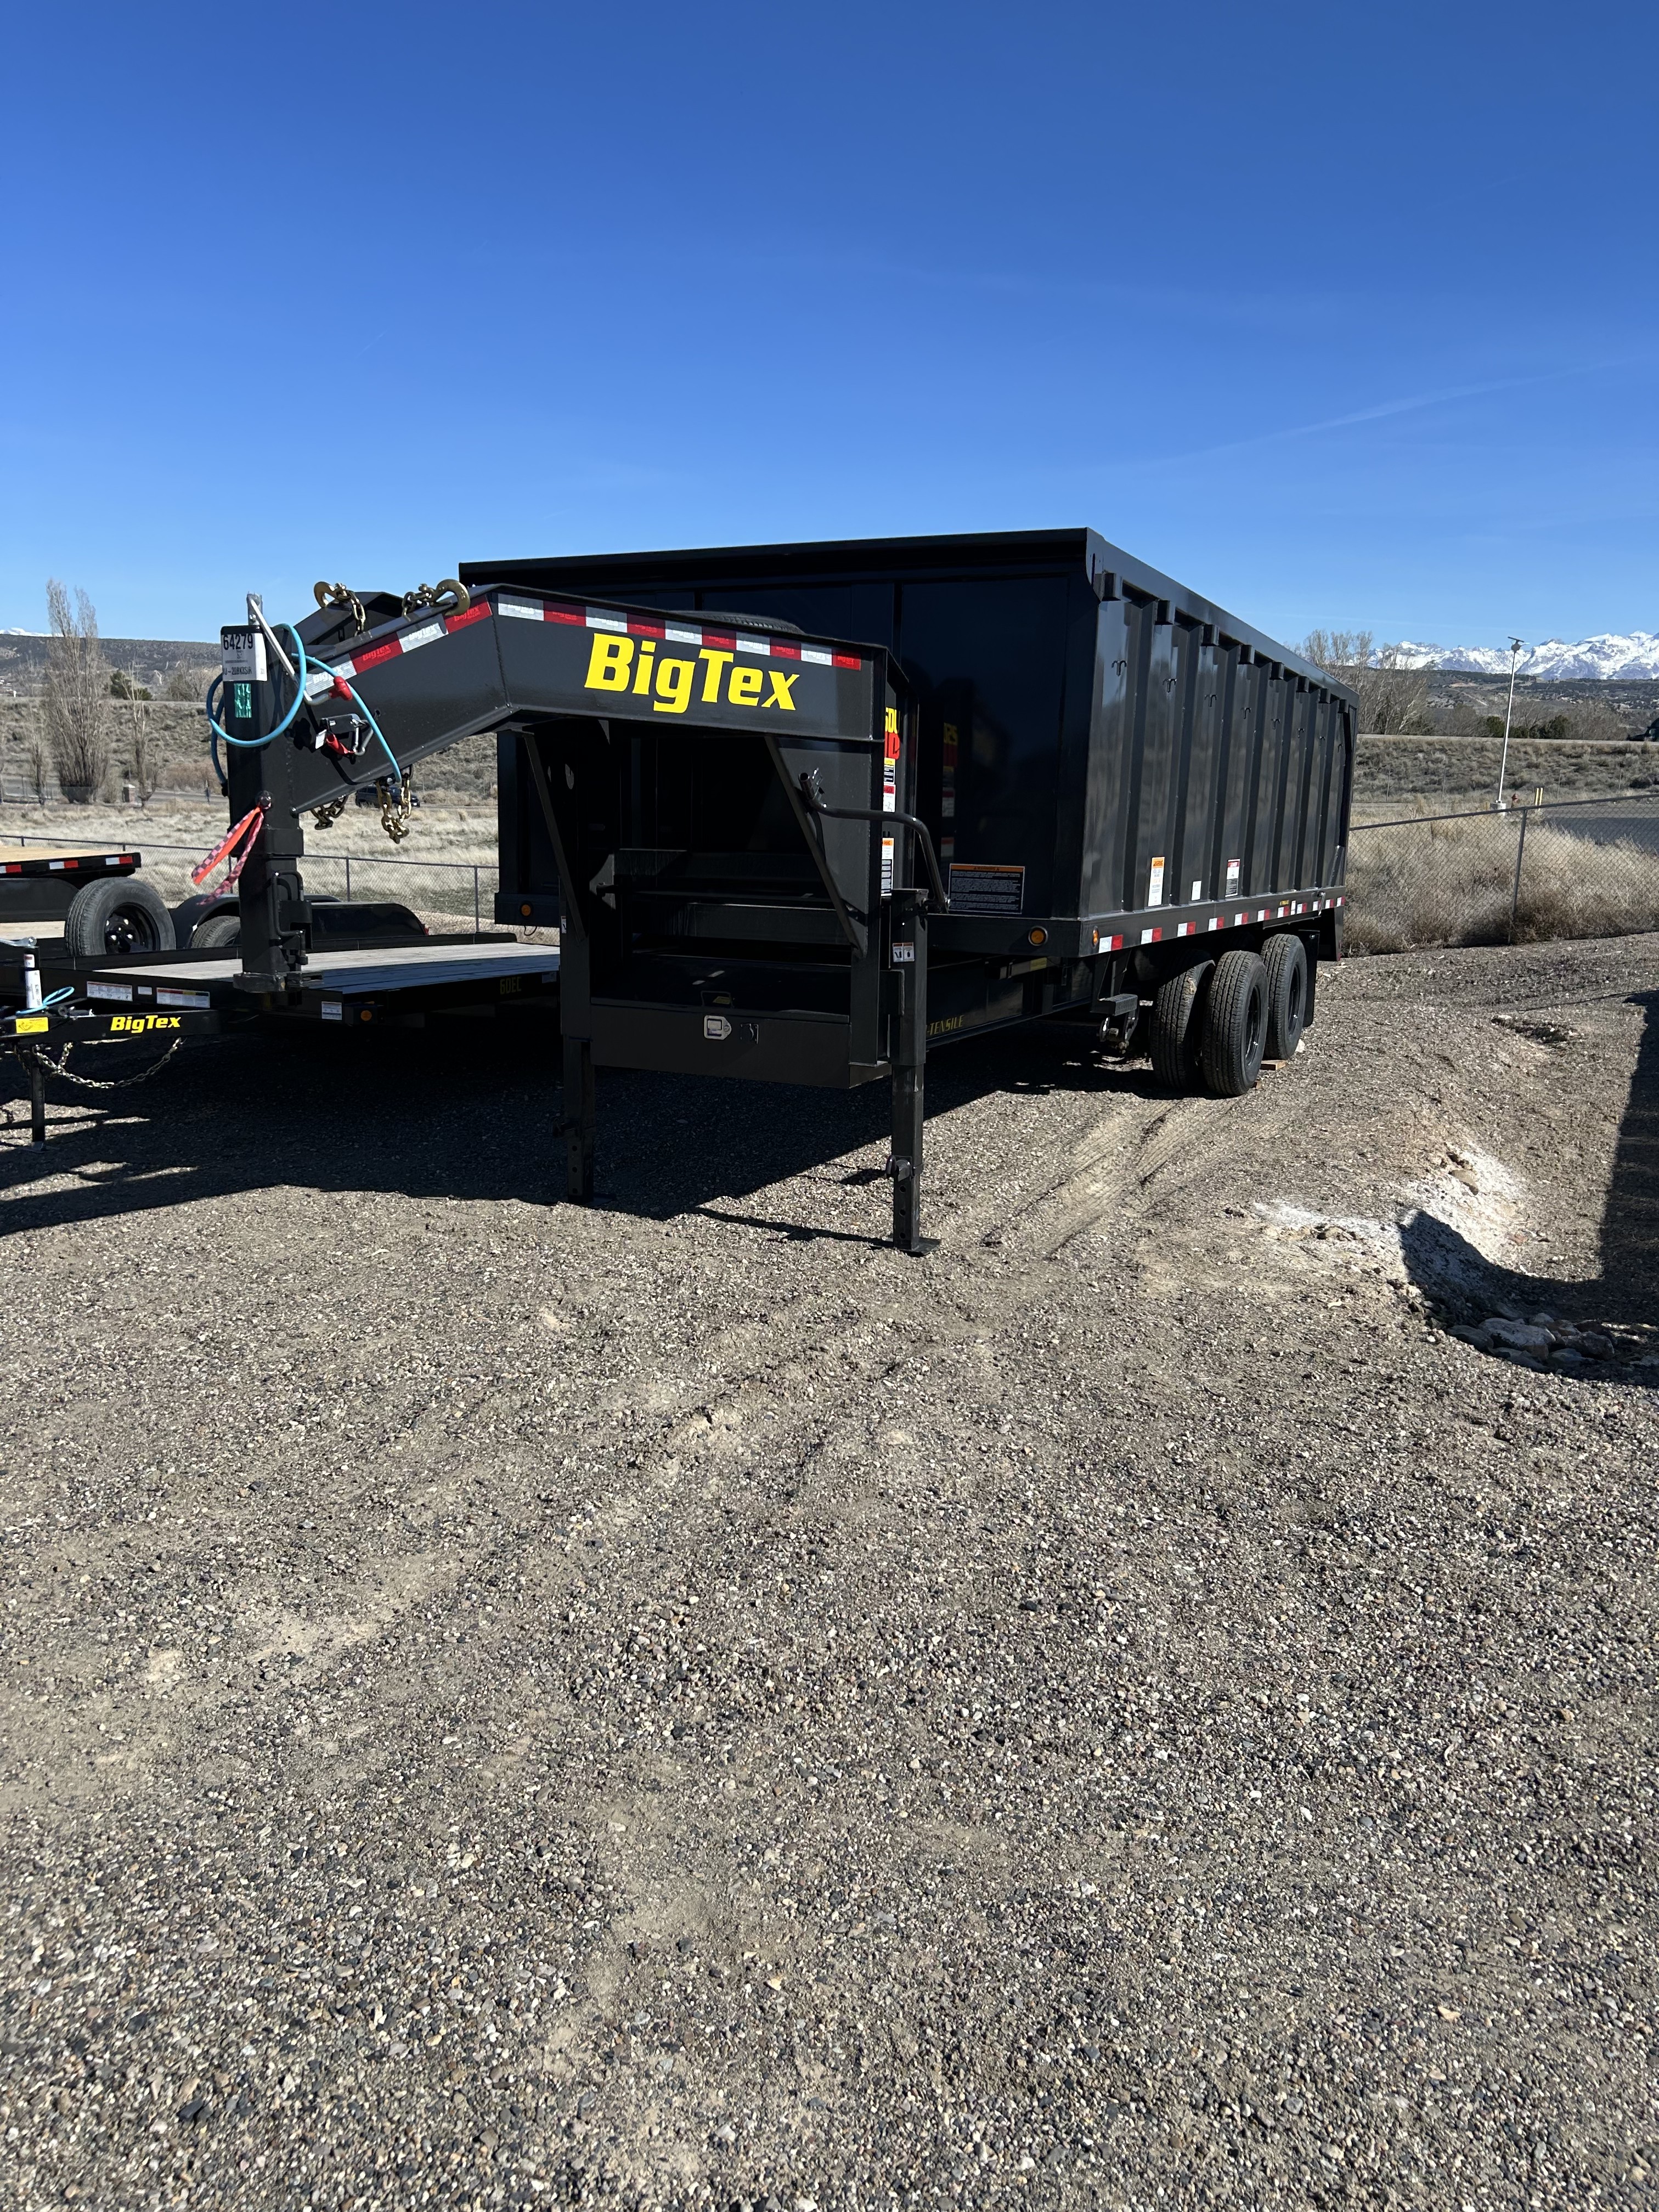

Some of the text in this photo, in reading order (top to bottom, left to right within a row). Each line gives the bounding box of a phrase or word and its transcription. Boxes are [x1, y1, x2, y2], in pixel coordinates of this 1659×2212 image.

[223, 633, 253, 651] 64279
[584, 633, 800, 713] BigTex
[110, 1015, 181, 1034] BigTex
